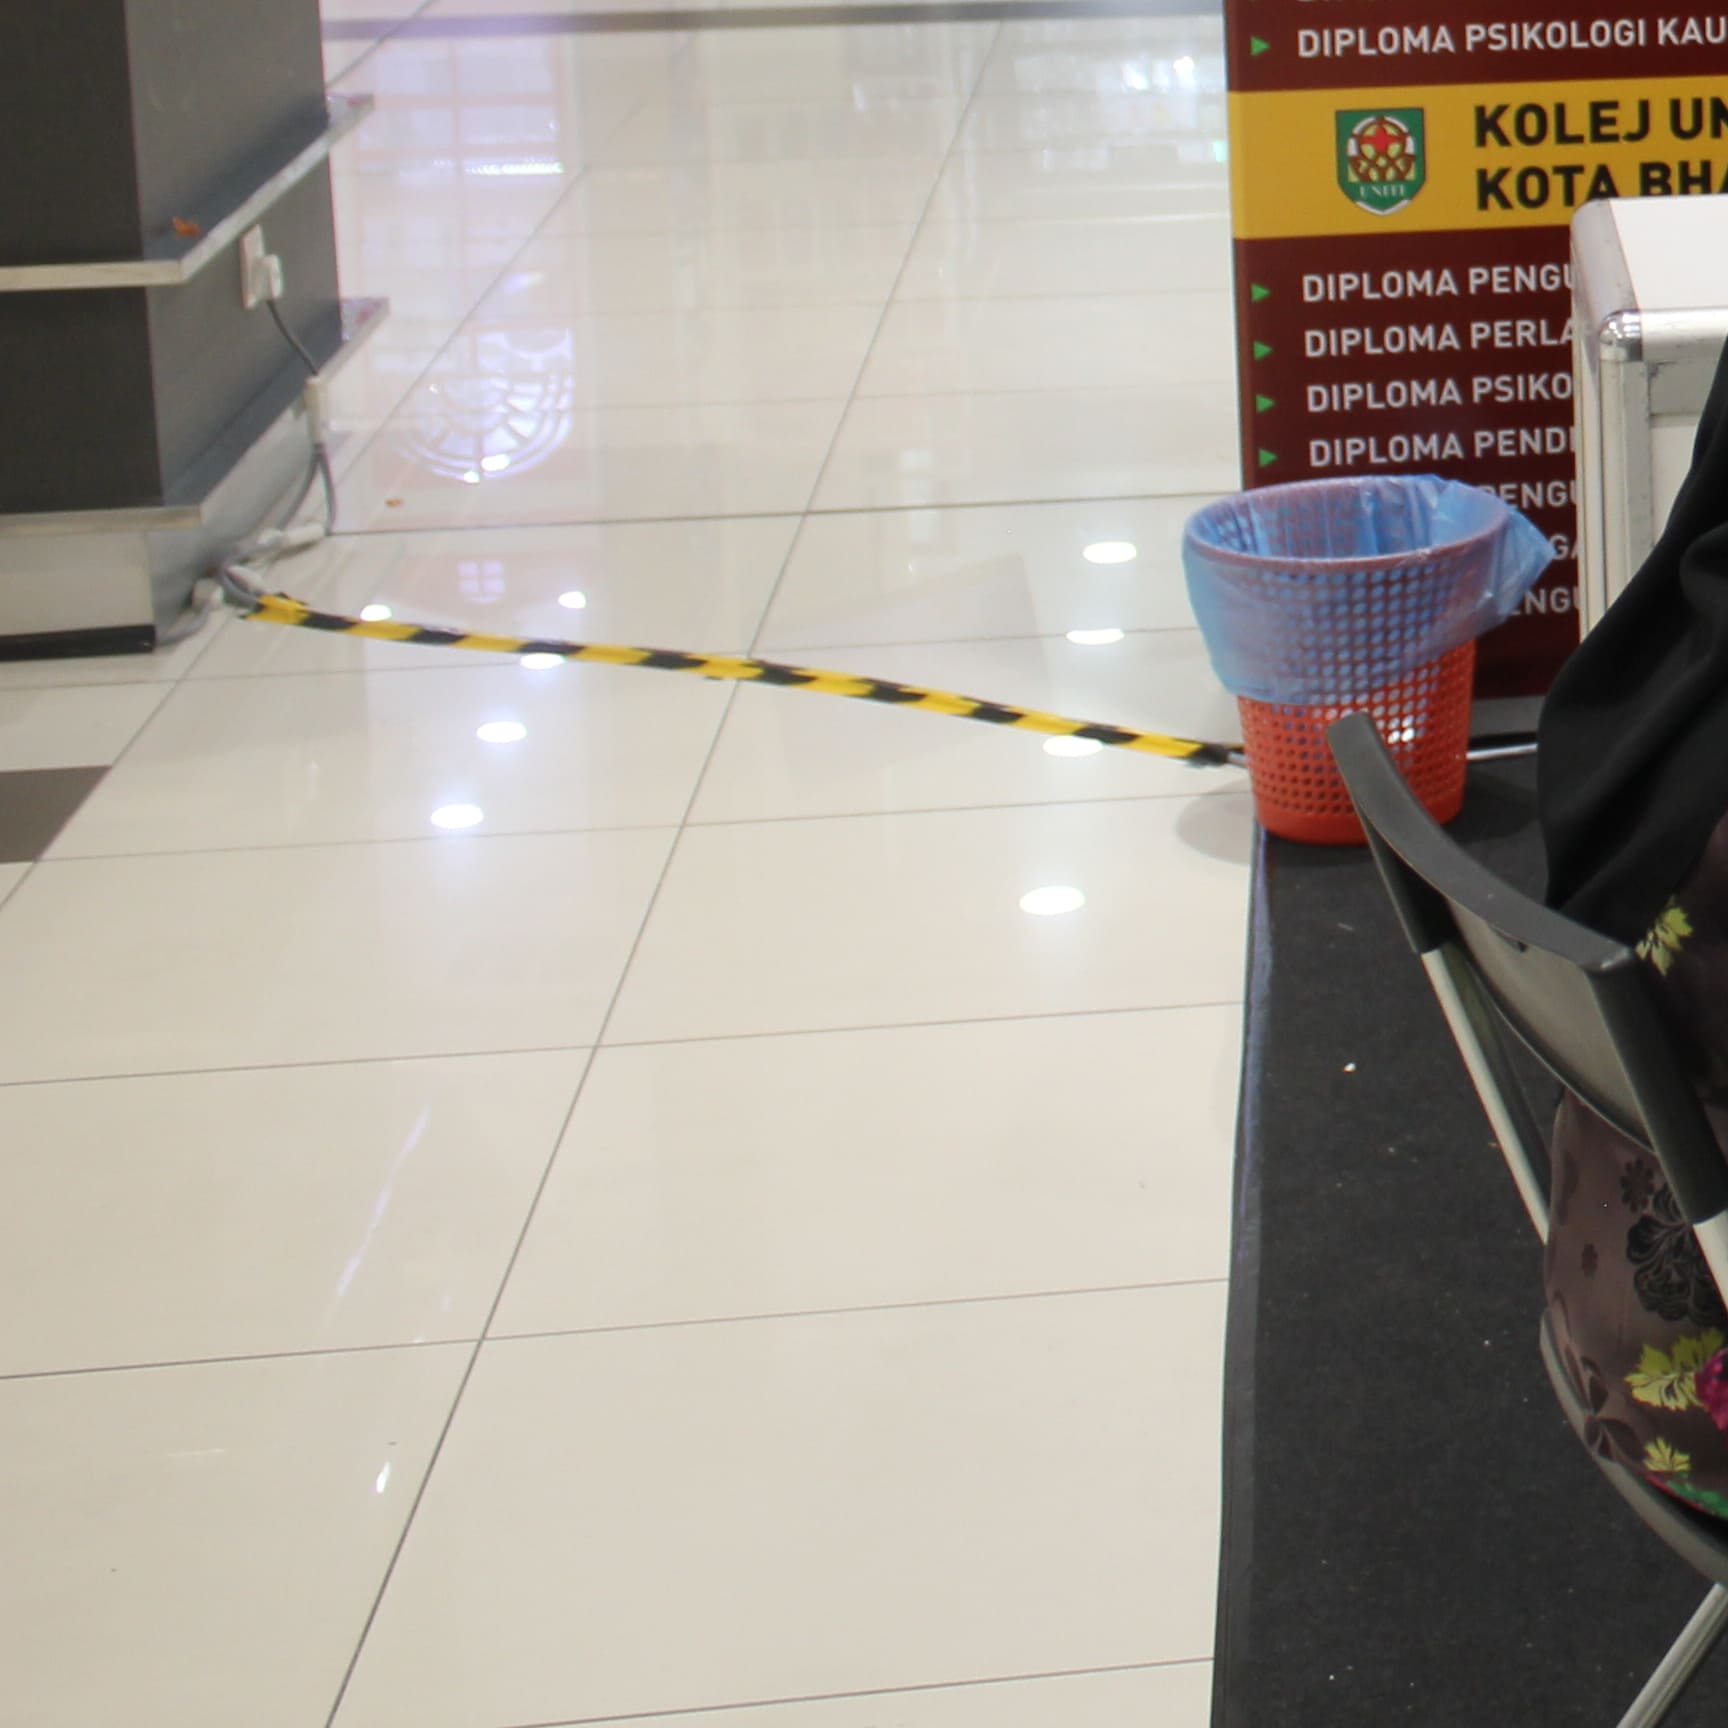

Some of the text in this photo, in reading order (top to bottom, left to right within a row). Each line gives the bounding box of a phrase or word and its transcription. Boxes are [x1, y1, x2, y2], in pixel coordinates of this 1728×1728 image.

[1298, 25, 1456, 58] DIPLOMA
[1465, 18, 1646, 52] PSIKOLOGI
[1475, 99, 1651, 148] KOLEJ
[1476, 165, 1618, 211] KOTA
[1307, 378, 1462, 413] DIPLOMA
